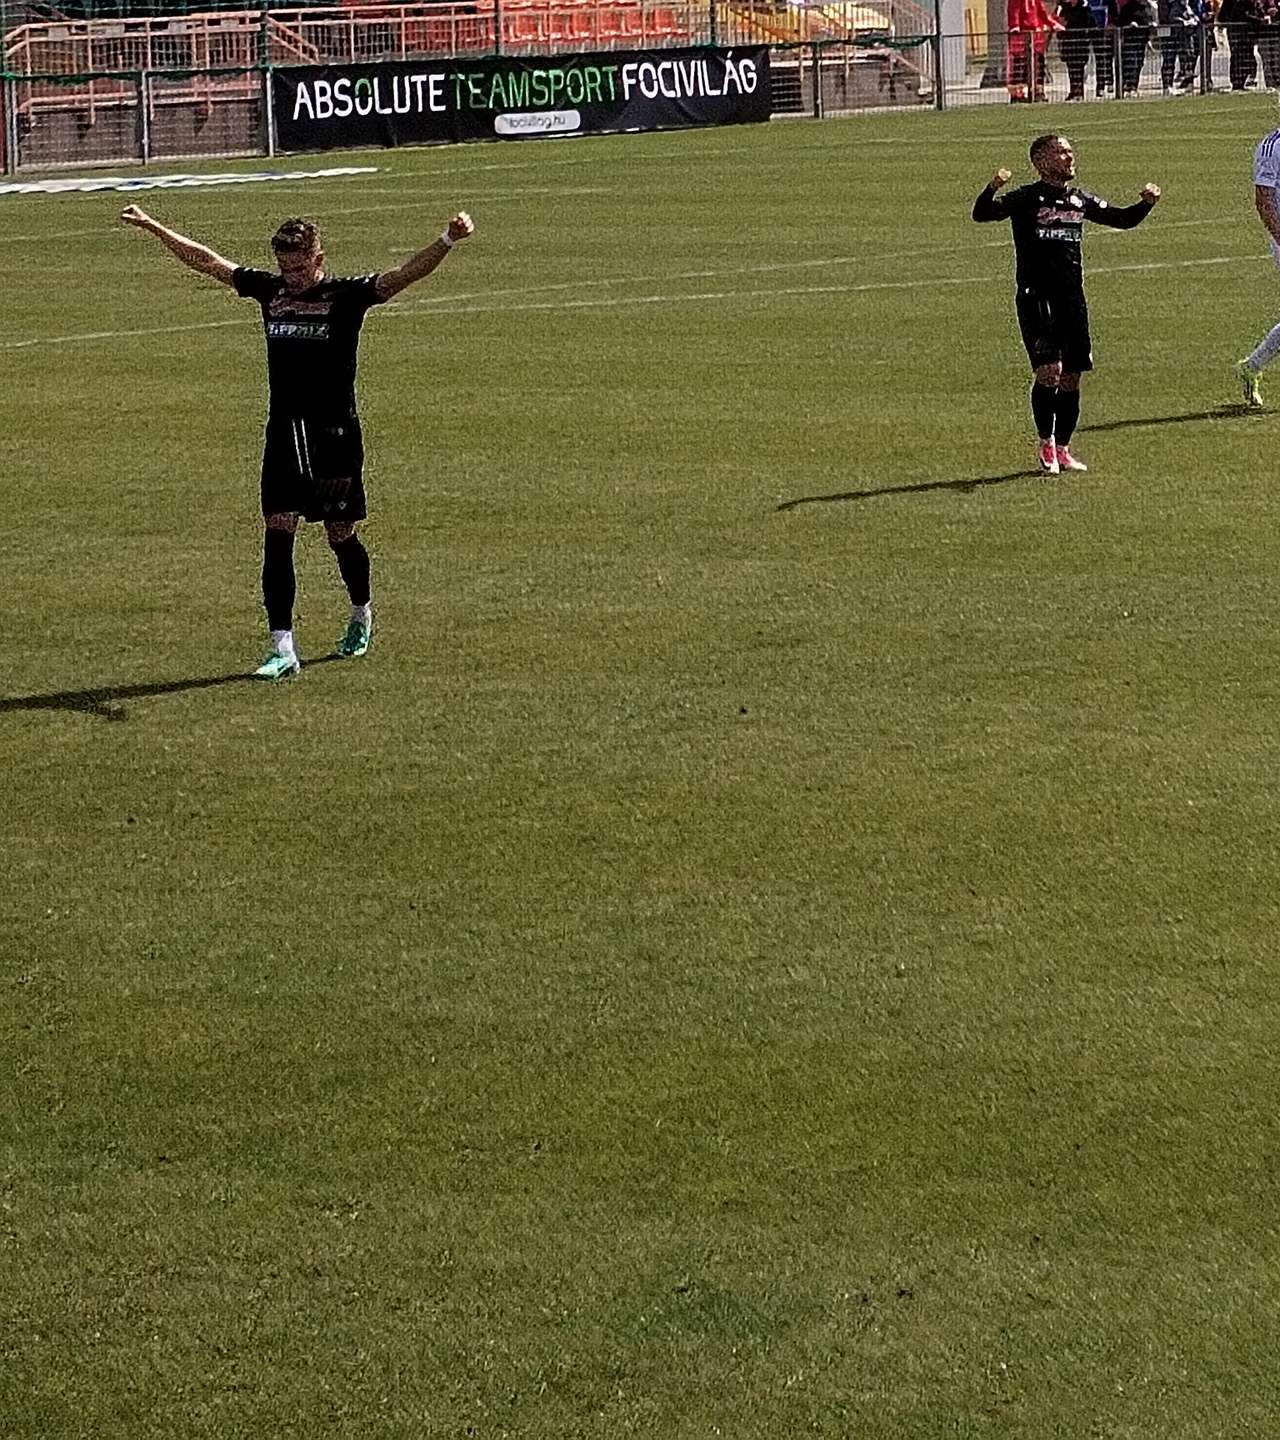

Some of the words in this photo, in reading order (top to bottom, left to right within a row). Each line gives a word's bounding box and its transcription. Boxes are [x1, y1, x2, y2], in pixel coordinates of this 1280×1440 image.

[293, 73, 446, 120] ABSOLUTE
[450, 66, 618, 109] TEAMSPORT
[622, 51, 757, 101] FOCIVILÁG
